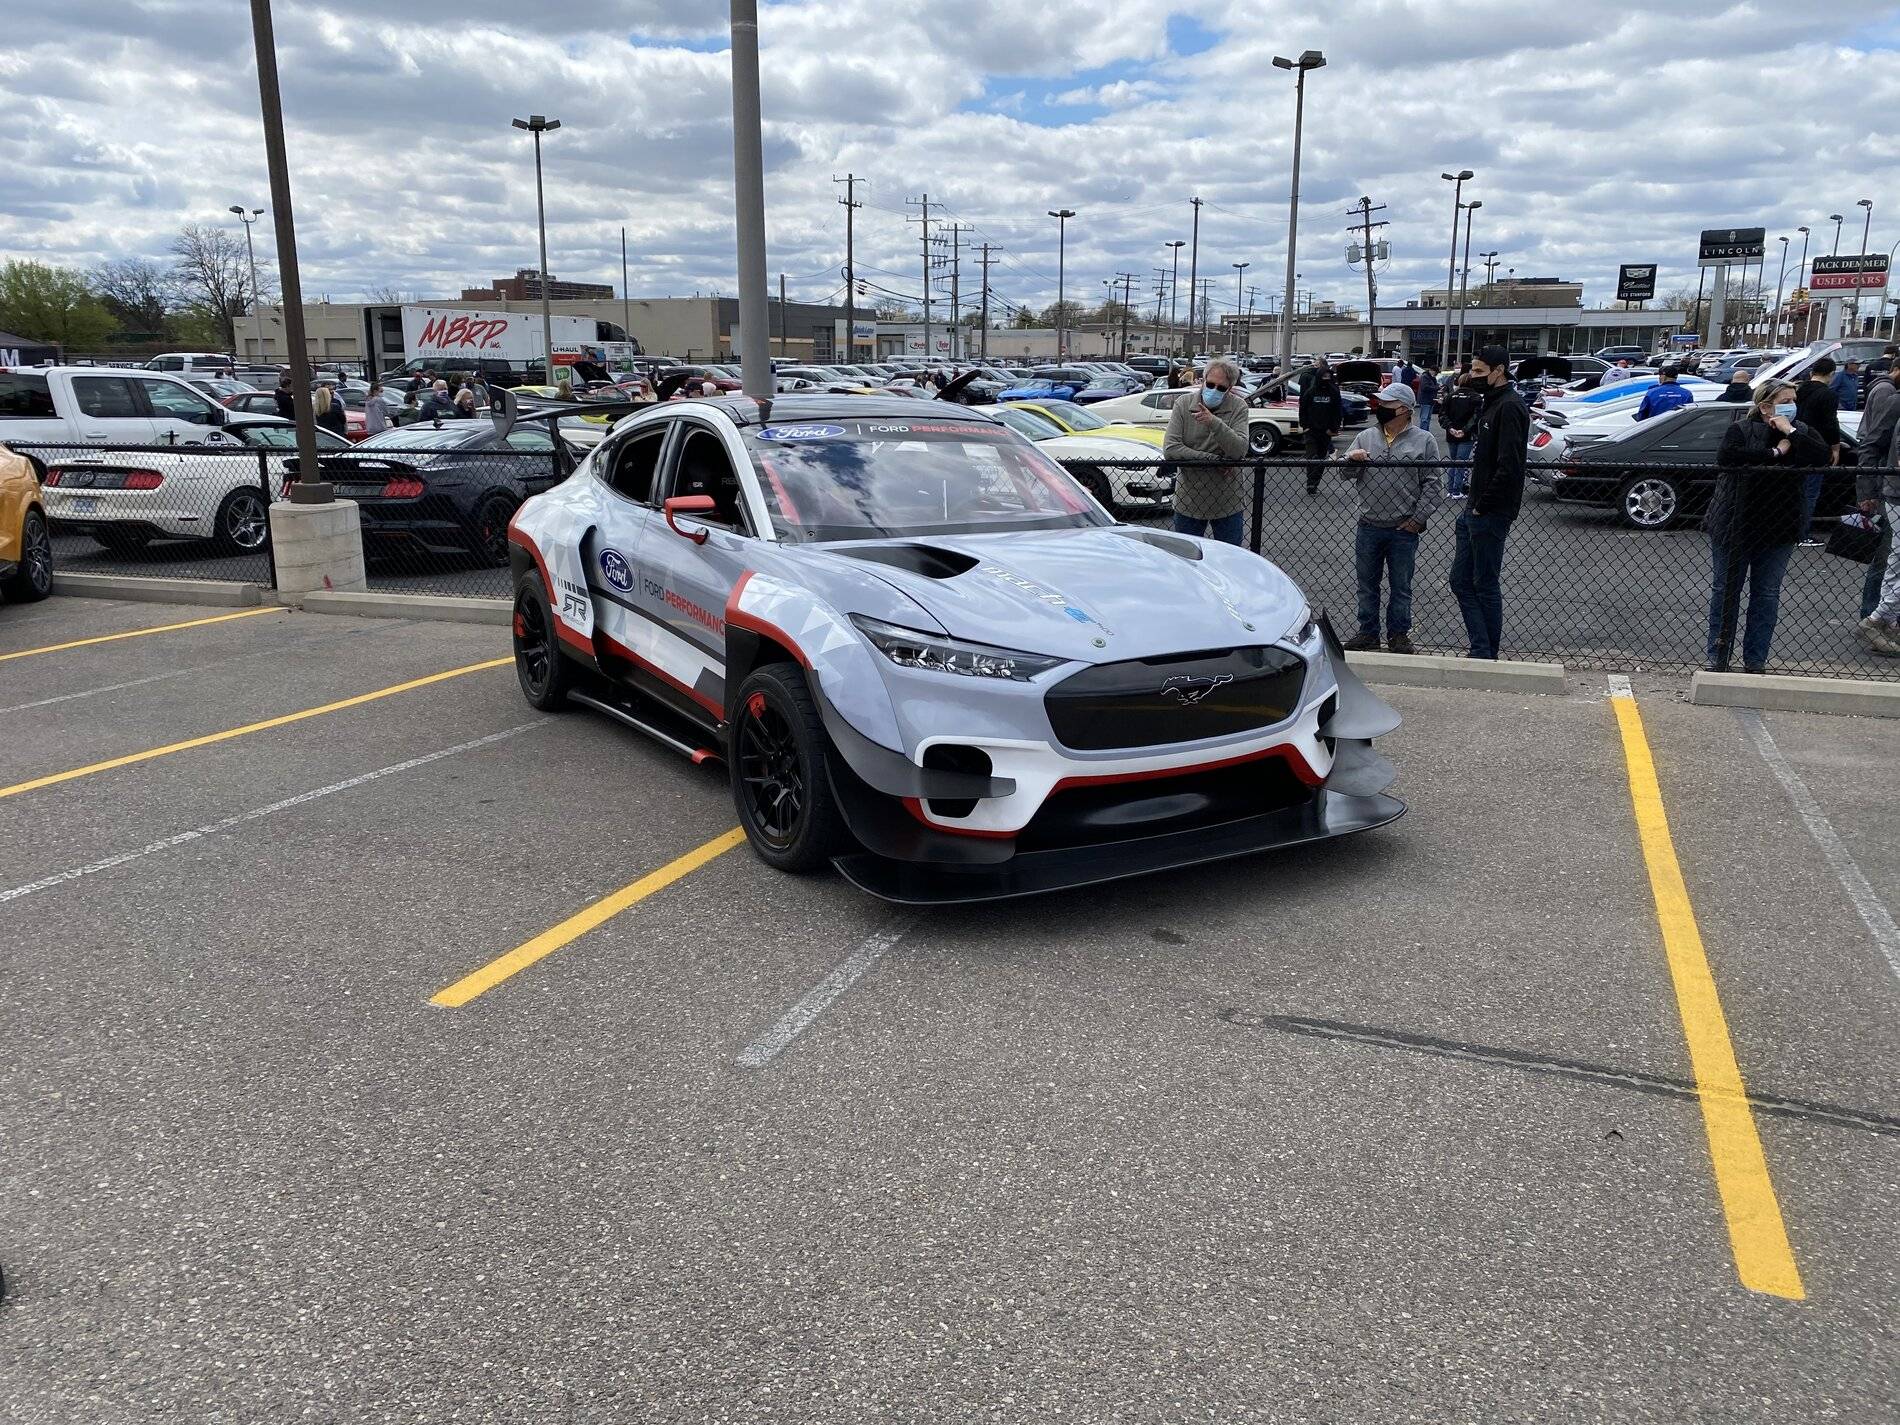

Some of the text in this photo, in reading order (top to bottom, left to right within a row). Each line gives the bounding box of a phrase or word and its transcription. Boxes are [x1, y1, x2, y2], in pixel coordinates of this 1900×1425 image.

[1704, 246, 1760, 256] LINCOLN
[1815, 260, 1886, 270] JACK DEMMER
[1817, 276, 1880, 286] USED CARS
[417, 315, 508, 349] MBRP
[870, 424, 908, 433] FORD
[605, 554, 628, 587] Ford
[644, 579, 665, 600] FORD
